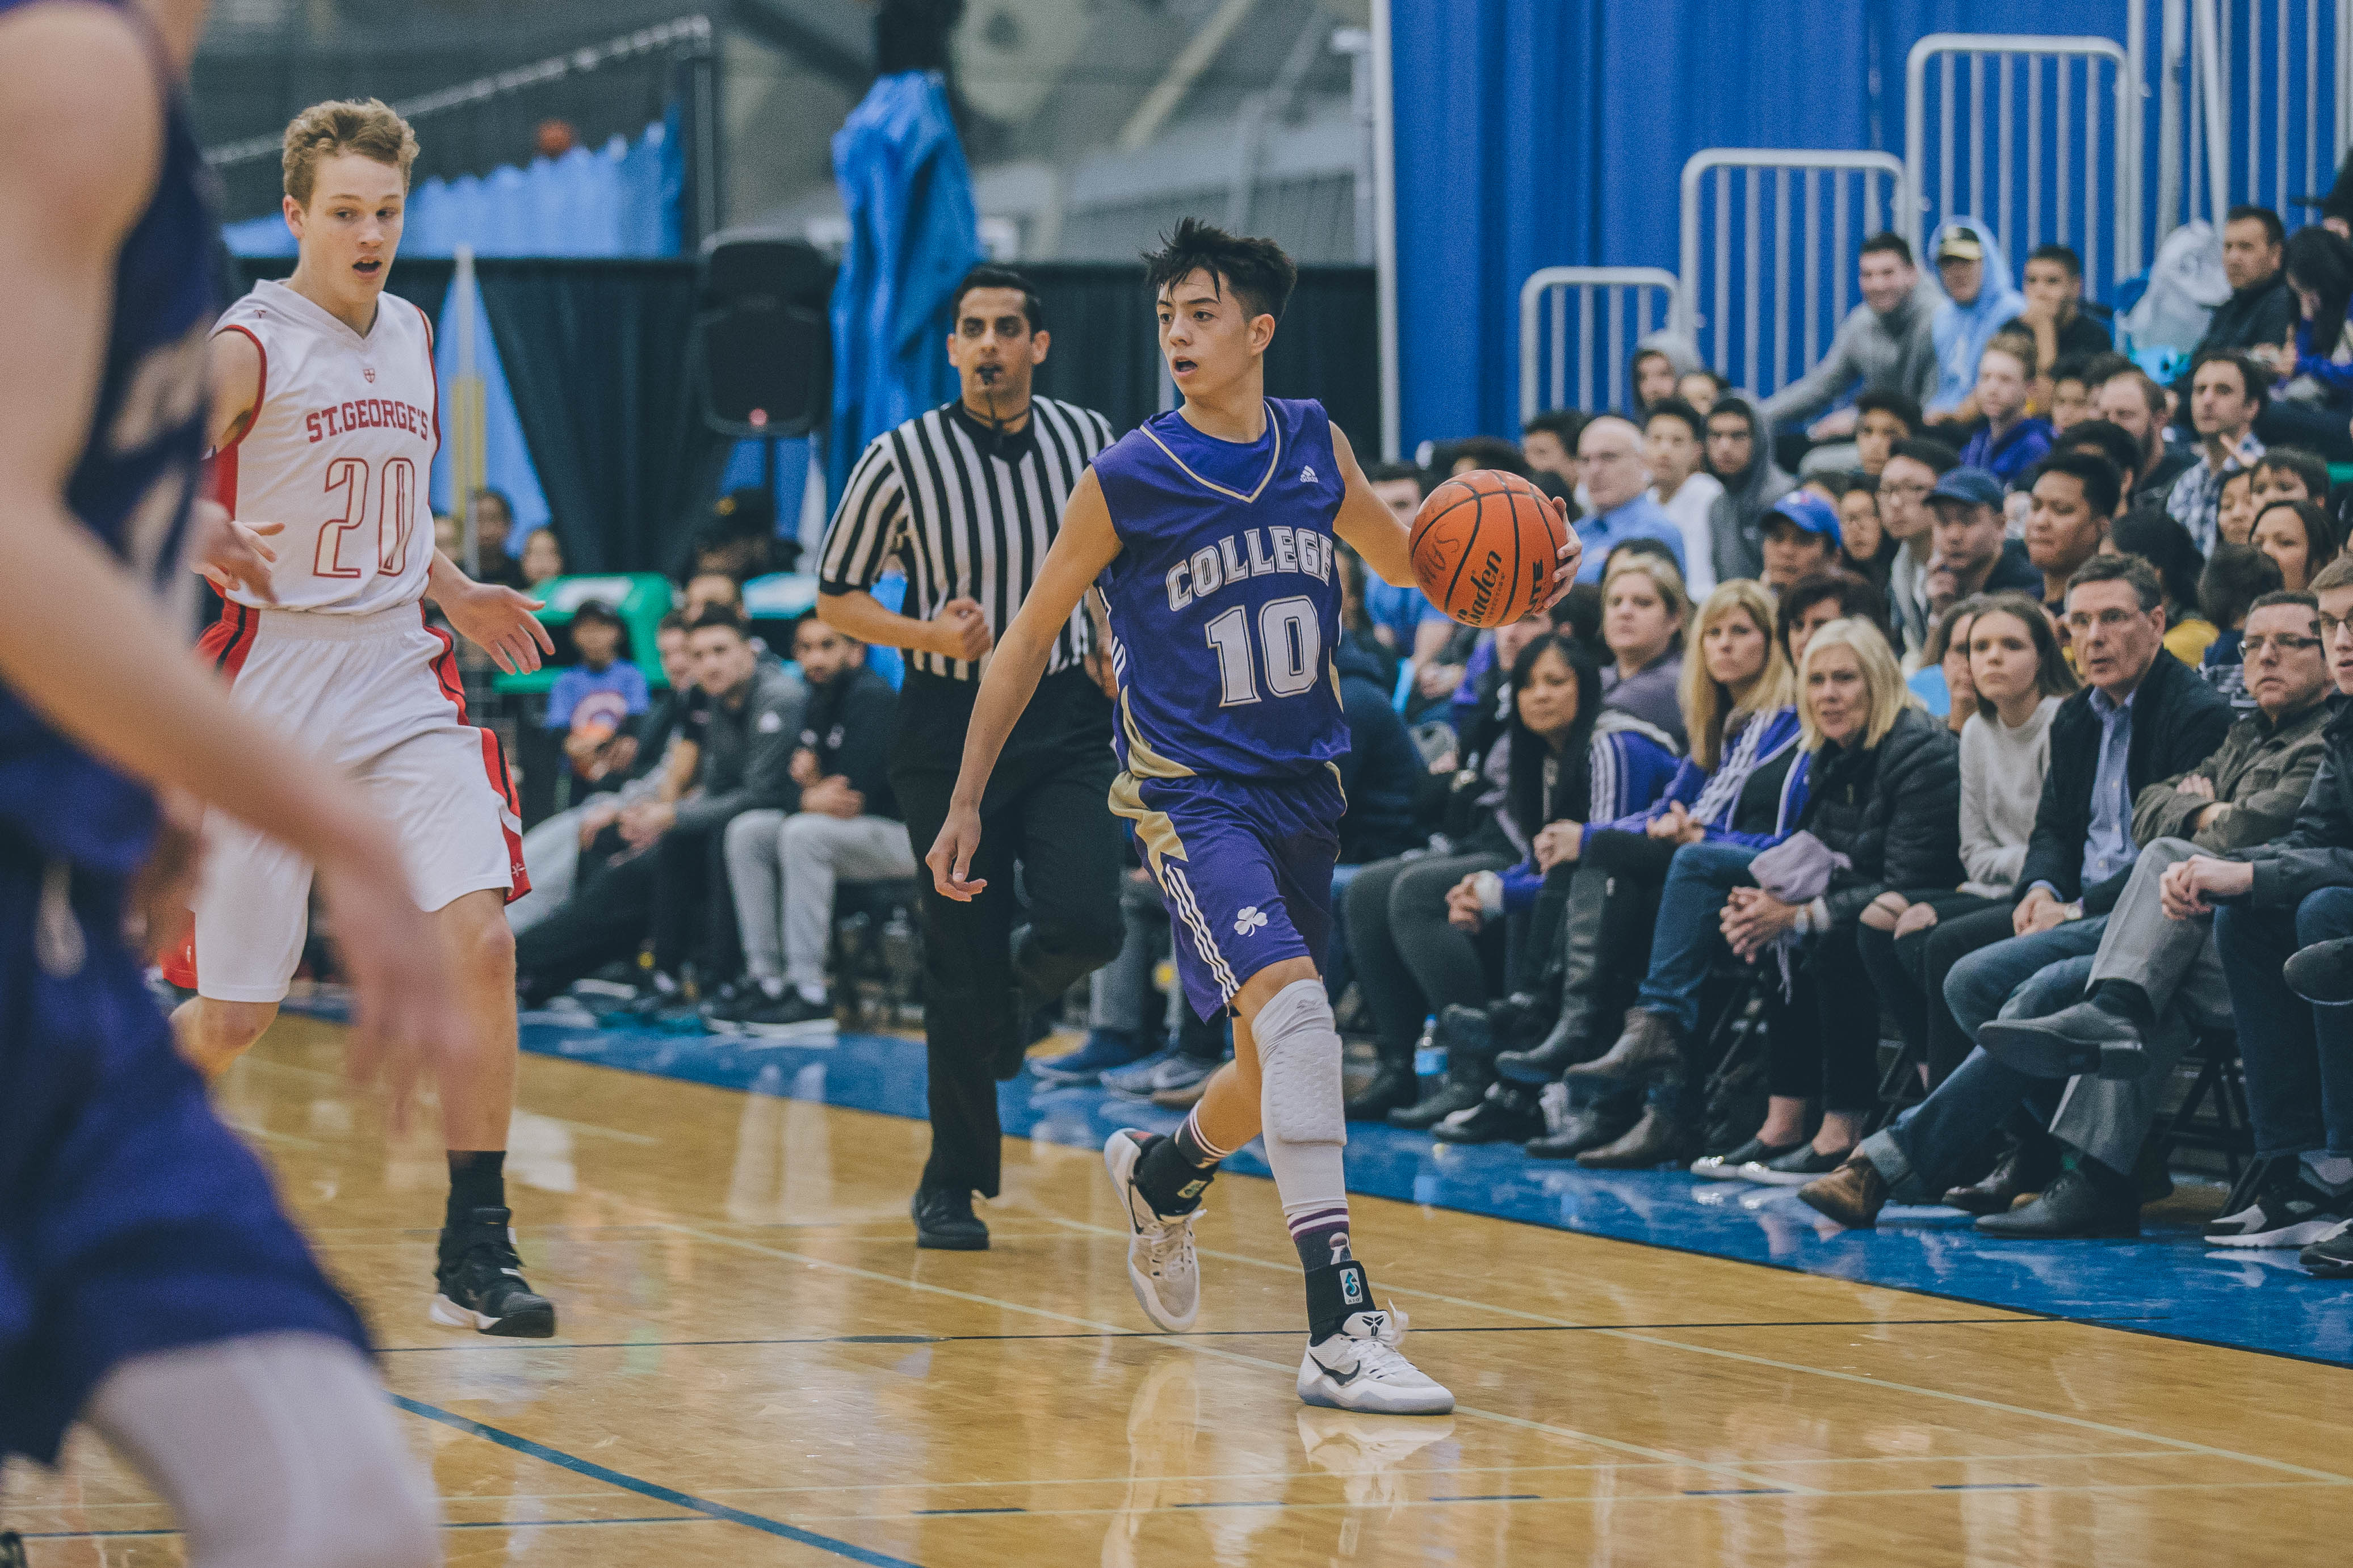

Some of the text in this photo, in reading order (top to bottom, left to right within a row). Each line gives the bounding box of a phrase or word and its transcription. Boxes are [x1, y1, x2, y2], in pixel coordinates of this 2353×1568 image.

[306, 399, 428, 443] ST.GEORGE'S
[313, 457, 416, 578] 20
[1165, 526, 1332, 612] COLLEGE
[1204, 595, 1320, 707] 10
